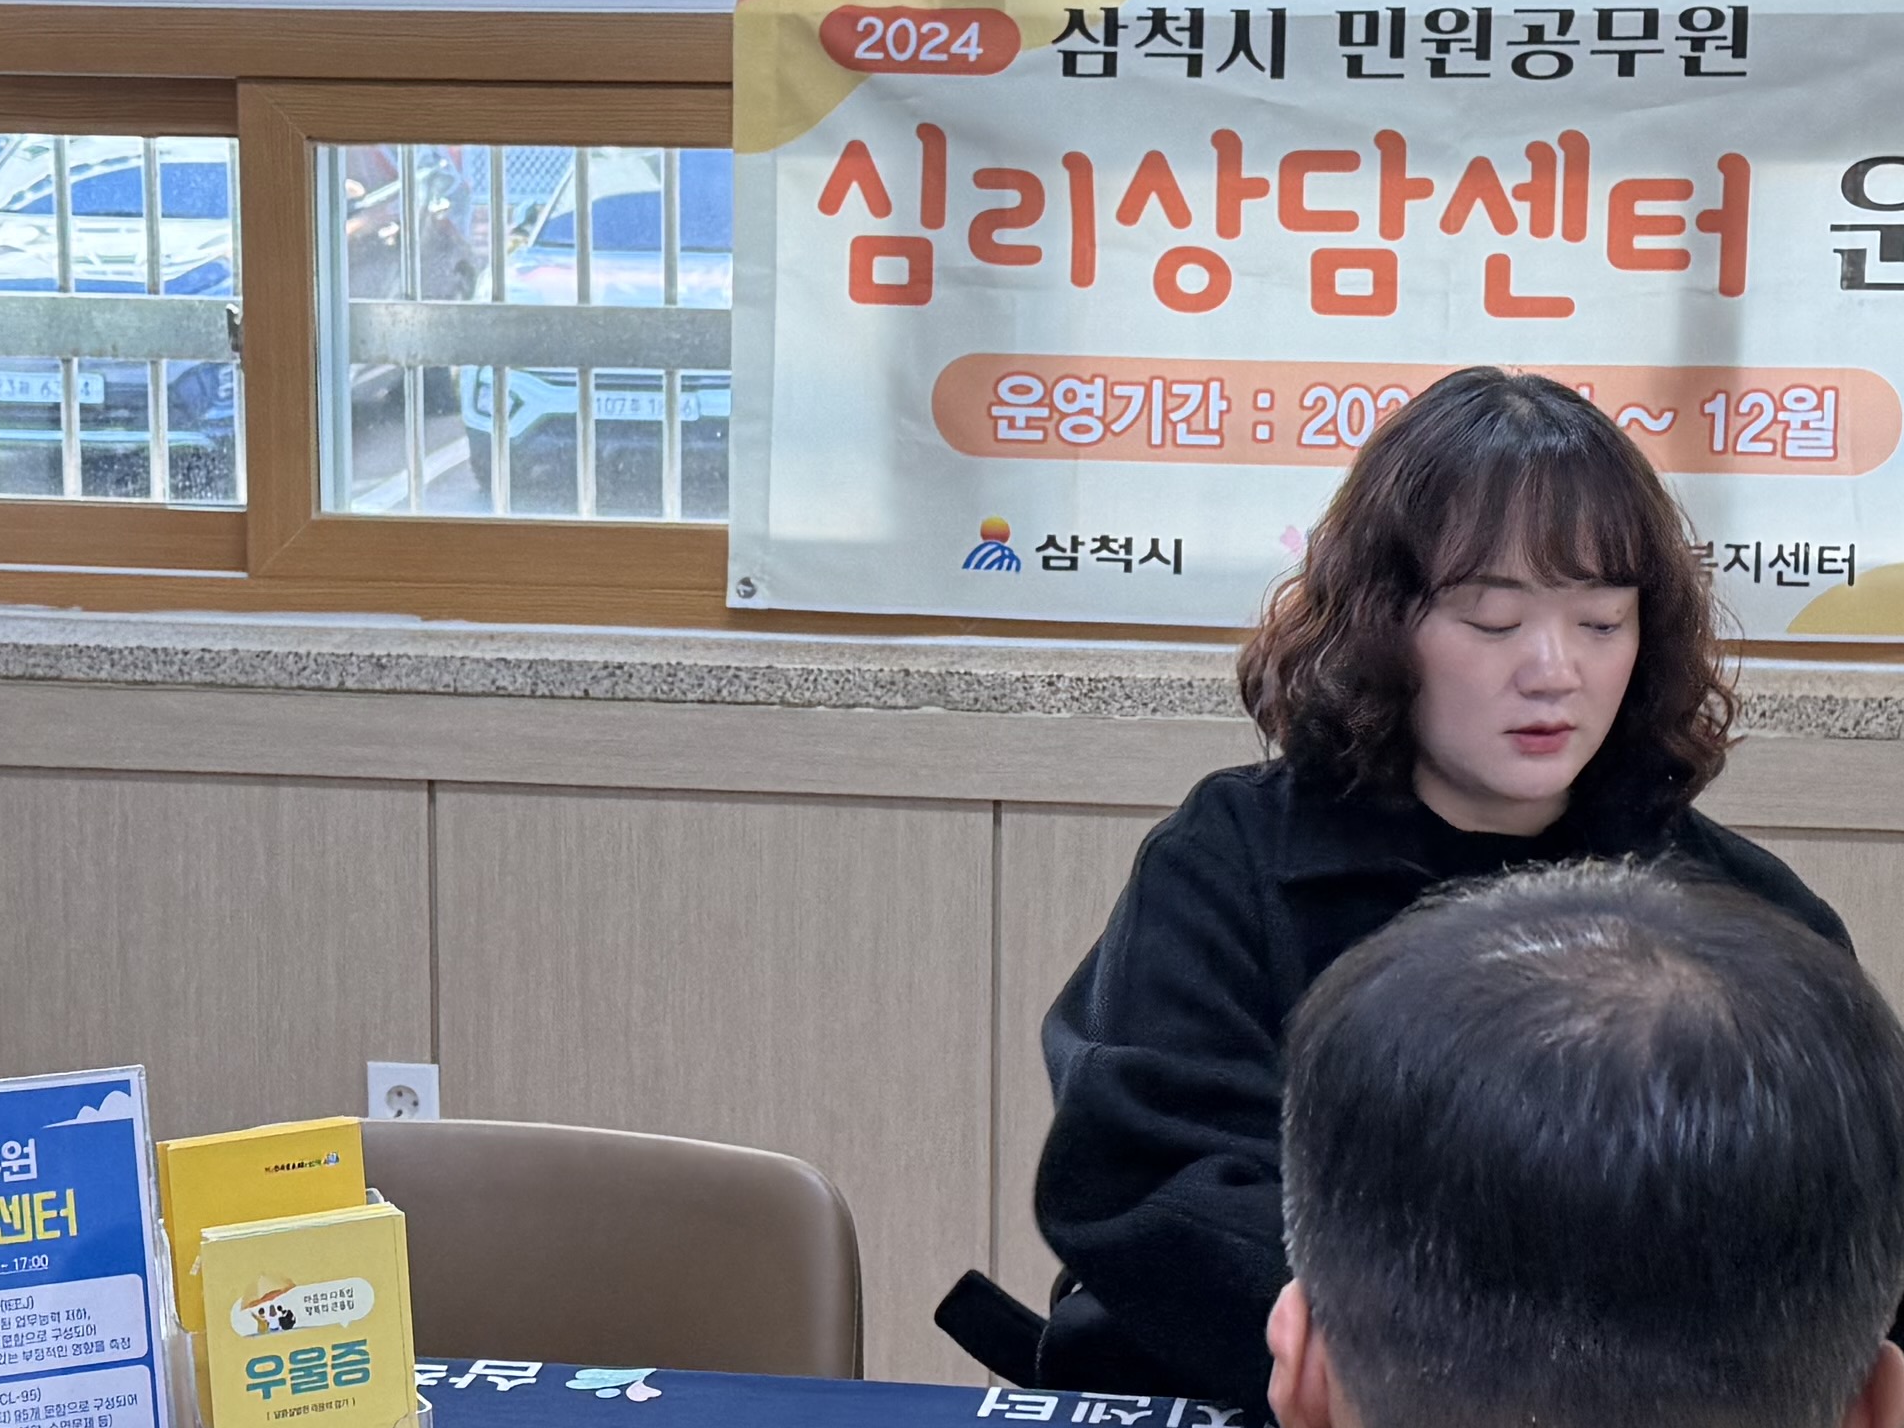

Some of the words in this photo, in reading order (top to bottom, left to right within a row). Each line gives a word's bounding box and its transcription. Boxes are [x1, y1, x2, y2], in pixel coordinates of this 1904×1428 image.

[852, 16, 985, 64] 2024
[1050, 4, 1290, 82] 삼척시
[1334, 2, 1754, 82] 민원공무원
[816, 121, 1752, 320] 심리상담센터
[989, 371, 1228, 448] 운영기간
[1701, 386, 1839, 460] 12월
[1035, 533, 1184, 575] 삼척시
[12, 1254, 49, 1271] 17:00
[51, 1324, 97, 1341] 구성되어
[245, 1338, 372, 1401] 우울증
[93, 1392, 139, 1411] 구성되어
